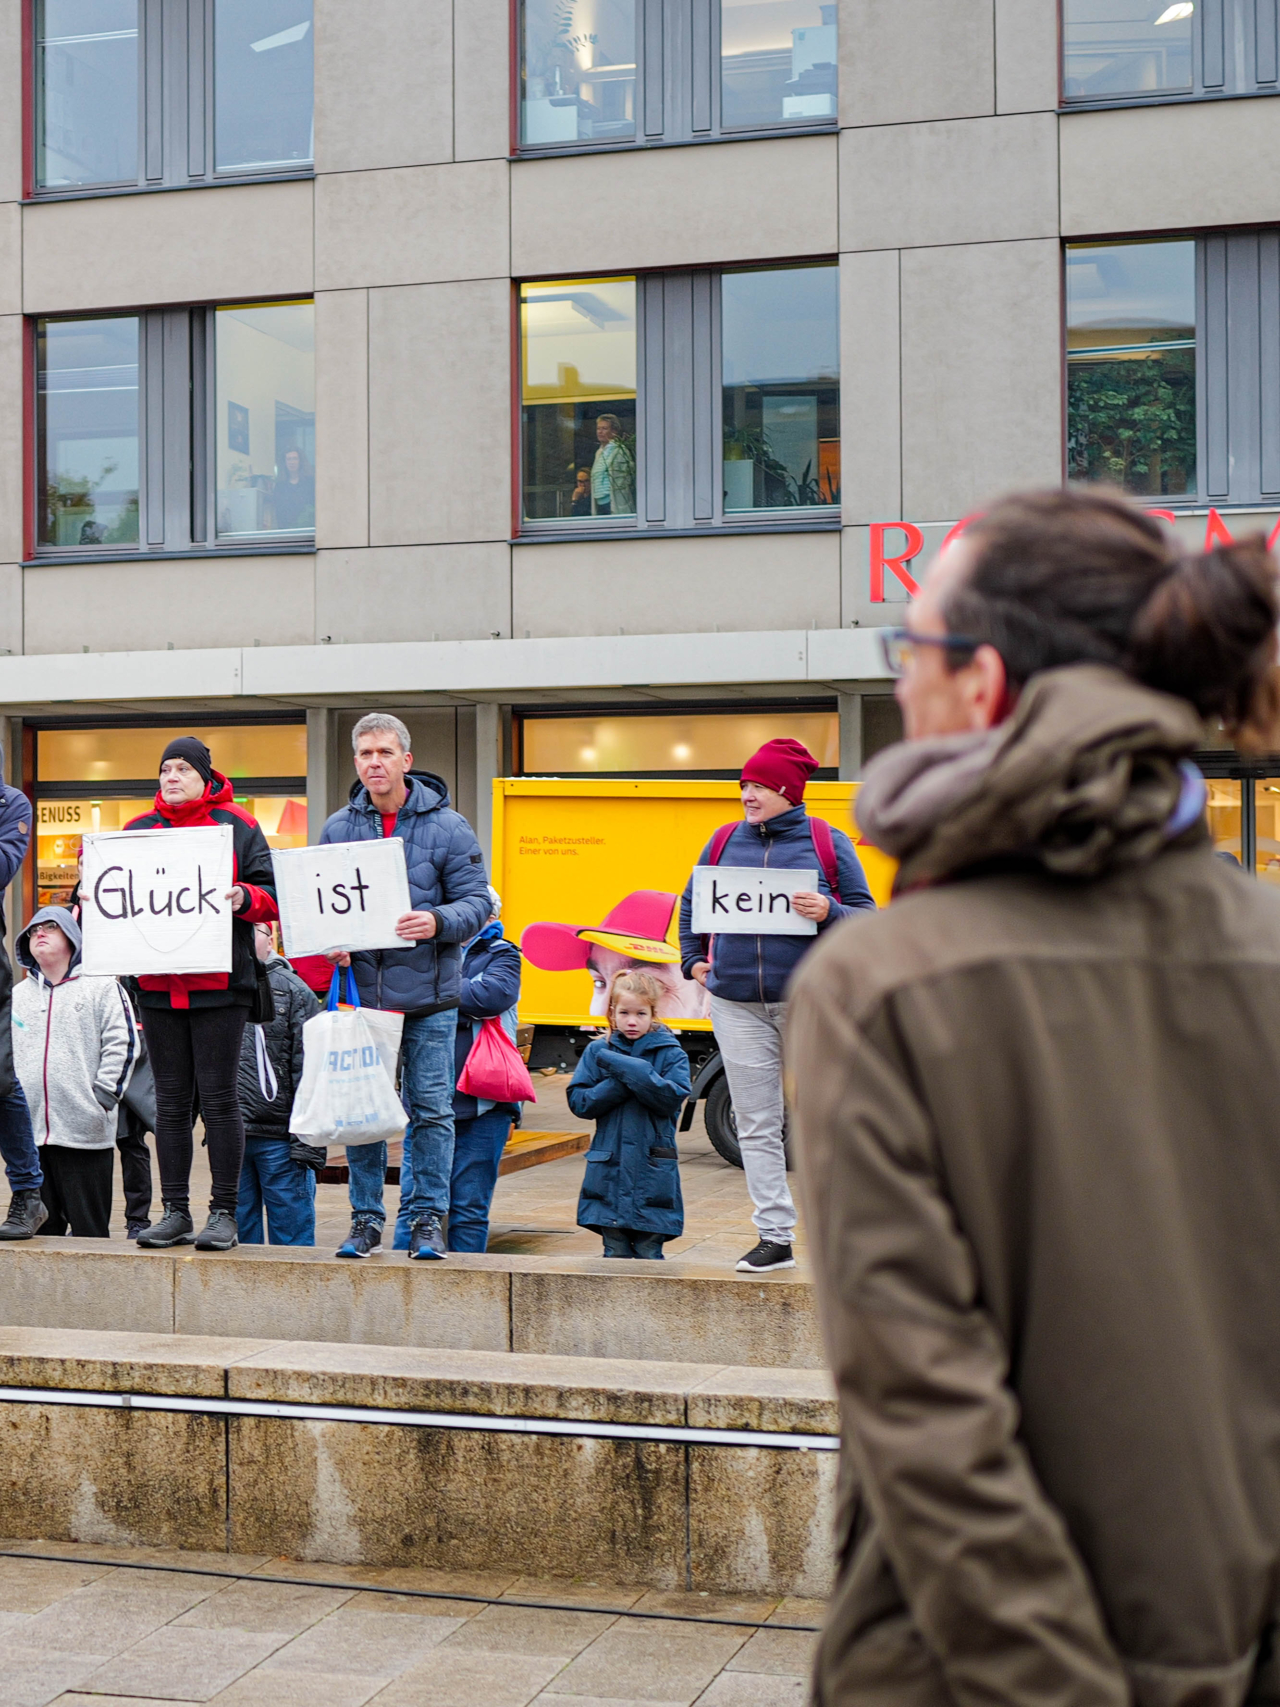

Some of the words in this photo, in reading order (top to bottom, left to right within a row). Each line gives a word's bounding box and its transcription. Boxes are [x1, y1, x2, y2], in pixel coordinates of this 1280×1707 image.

[37, 806, 81, 823] ENUSS
[519, 836, 541, 845] Alan,
[543, 836, 606, 845] Paketzusteller.
[519, 847, 541, 855] Einer
[37, 871, 80, 881] ßigkeiten
[94, 865, 220, 919] Glück
[316, 867, 369, 914] ist
[712, 879, 790, 914] kein
